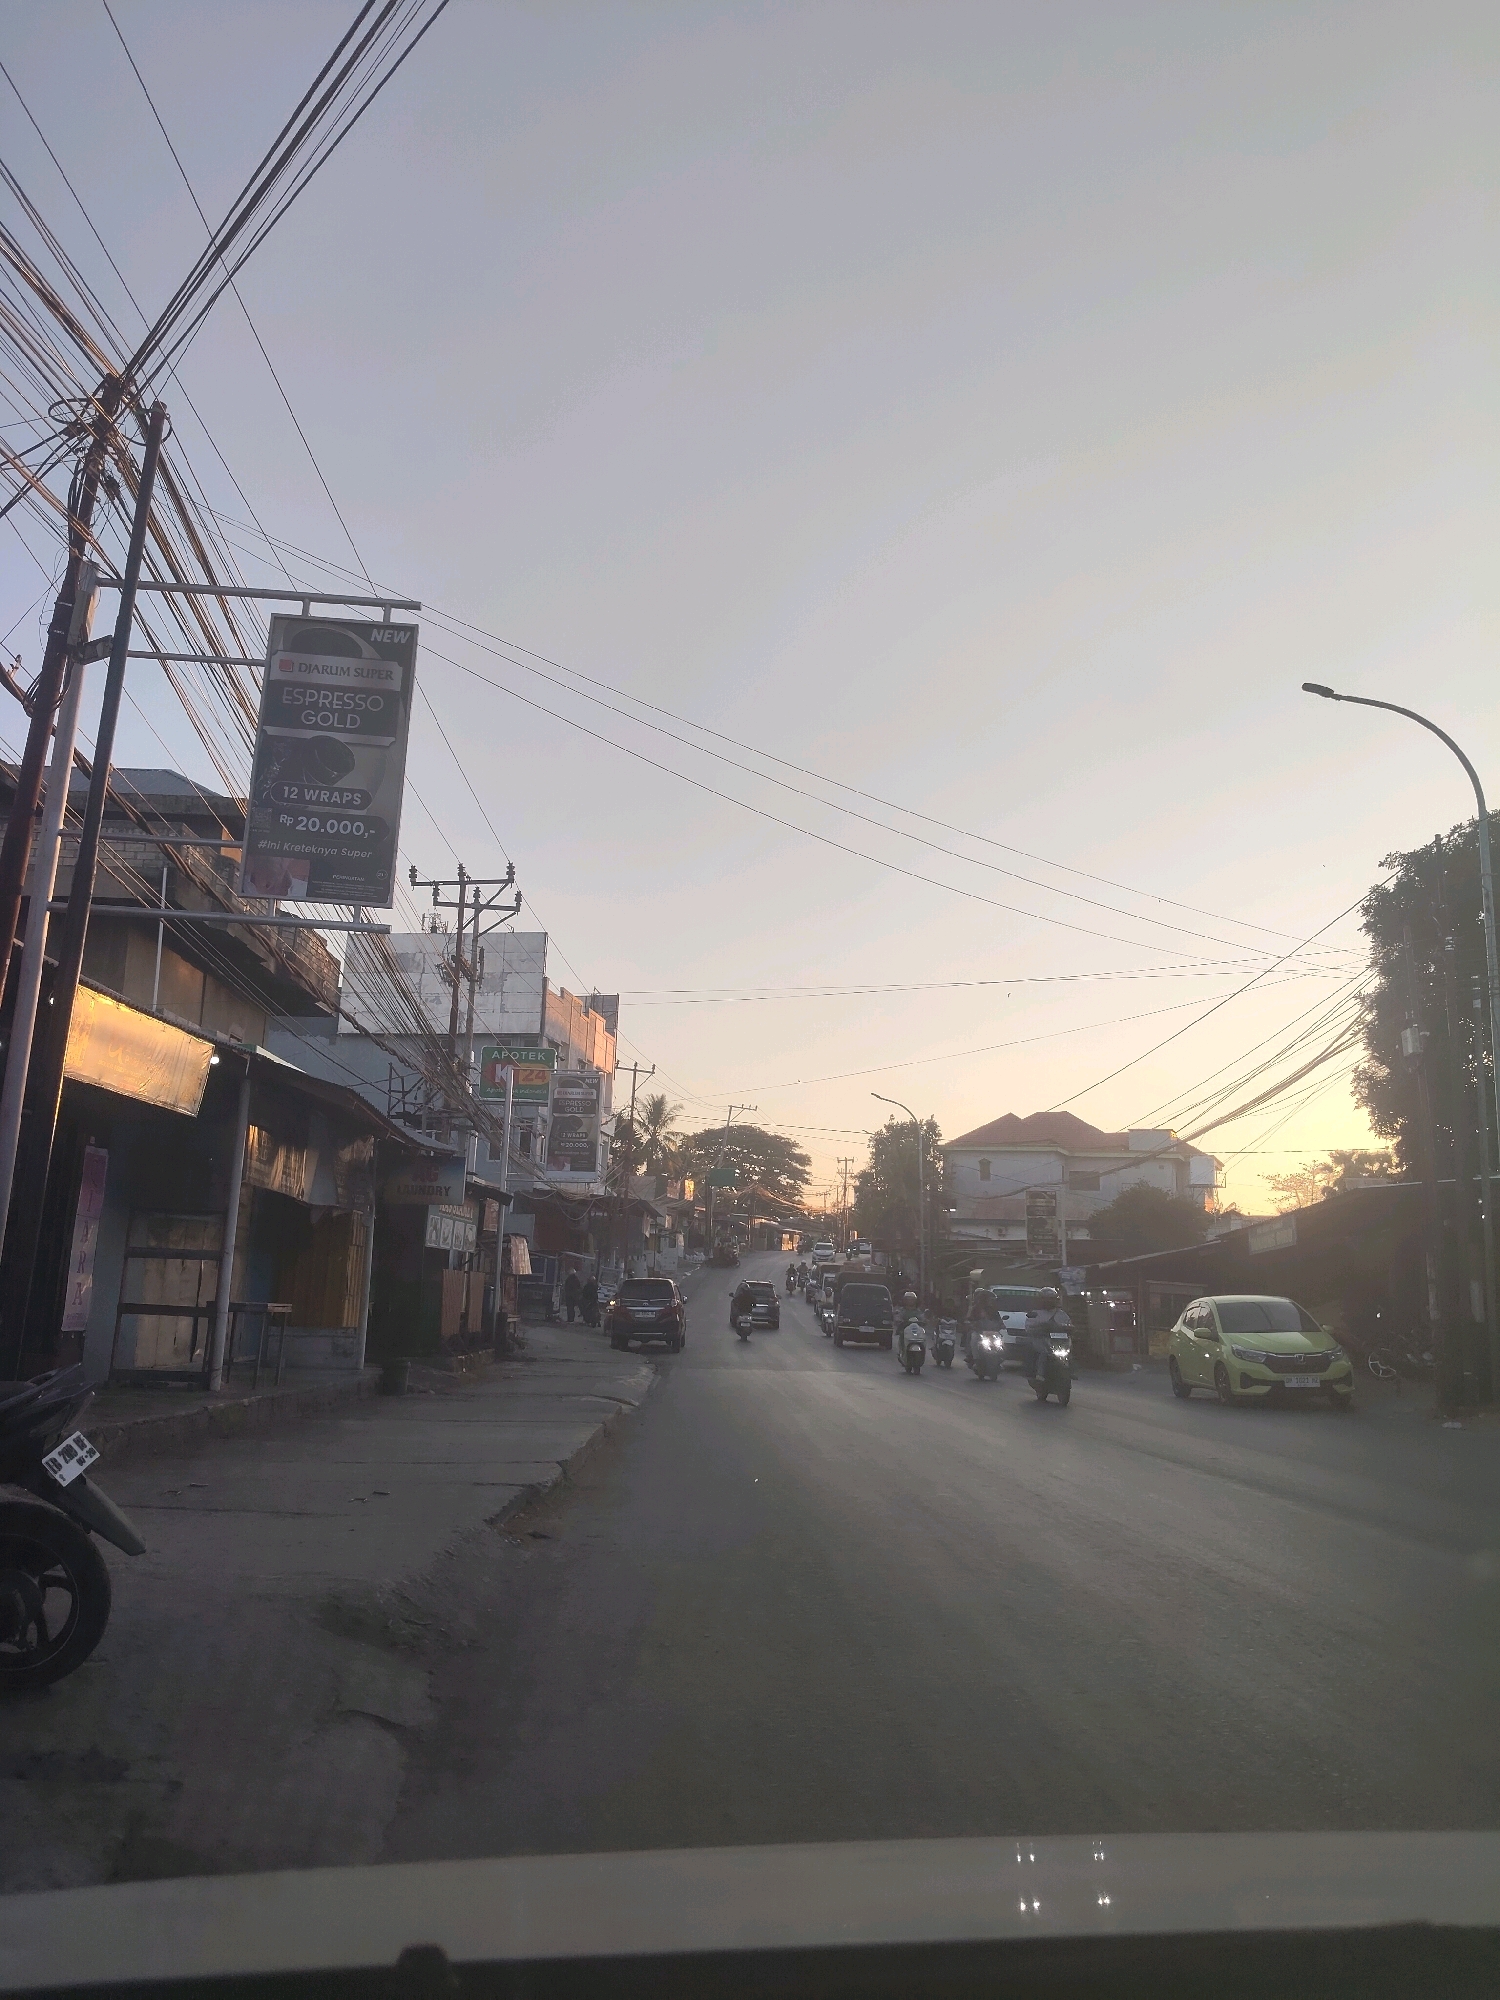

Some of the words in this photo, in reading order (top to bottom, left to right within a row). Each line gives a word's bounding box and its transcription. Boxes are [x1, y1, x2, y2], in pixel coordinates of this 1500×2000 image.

[371, 628, 411, 644] NEW
[298, 662, 350, 677] DJARUM
[354, 667, 394, 681] SUPER
[282, 687, 384, 711] ESPRESSO
[301, 710, 361, 729] GOLD
[283, 786, 299, 799] 12
[304, 788, 362, 805] WRAPS
[280, 814, 294, 826] Rp
[257, 840, 281, 851] #Ini
[283, 842, 338, 857] Kreteknya
[341, 847, 373, 860] Super
[491, 1051, 546, 1060] APOTEK
[396, 1184, 452, 1197] LAUNDRY
